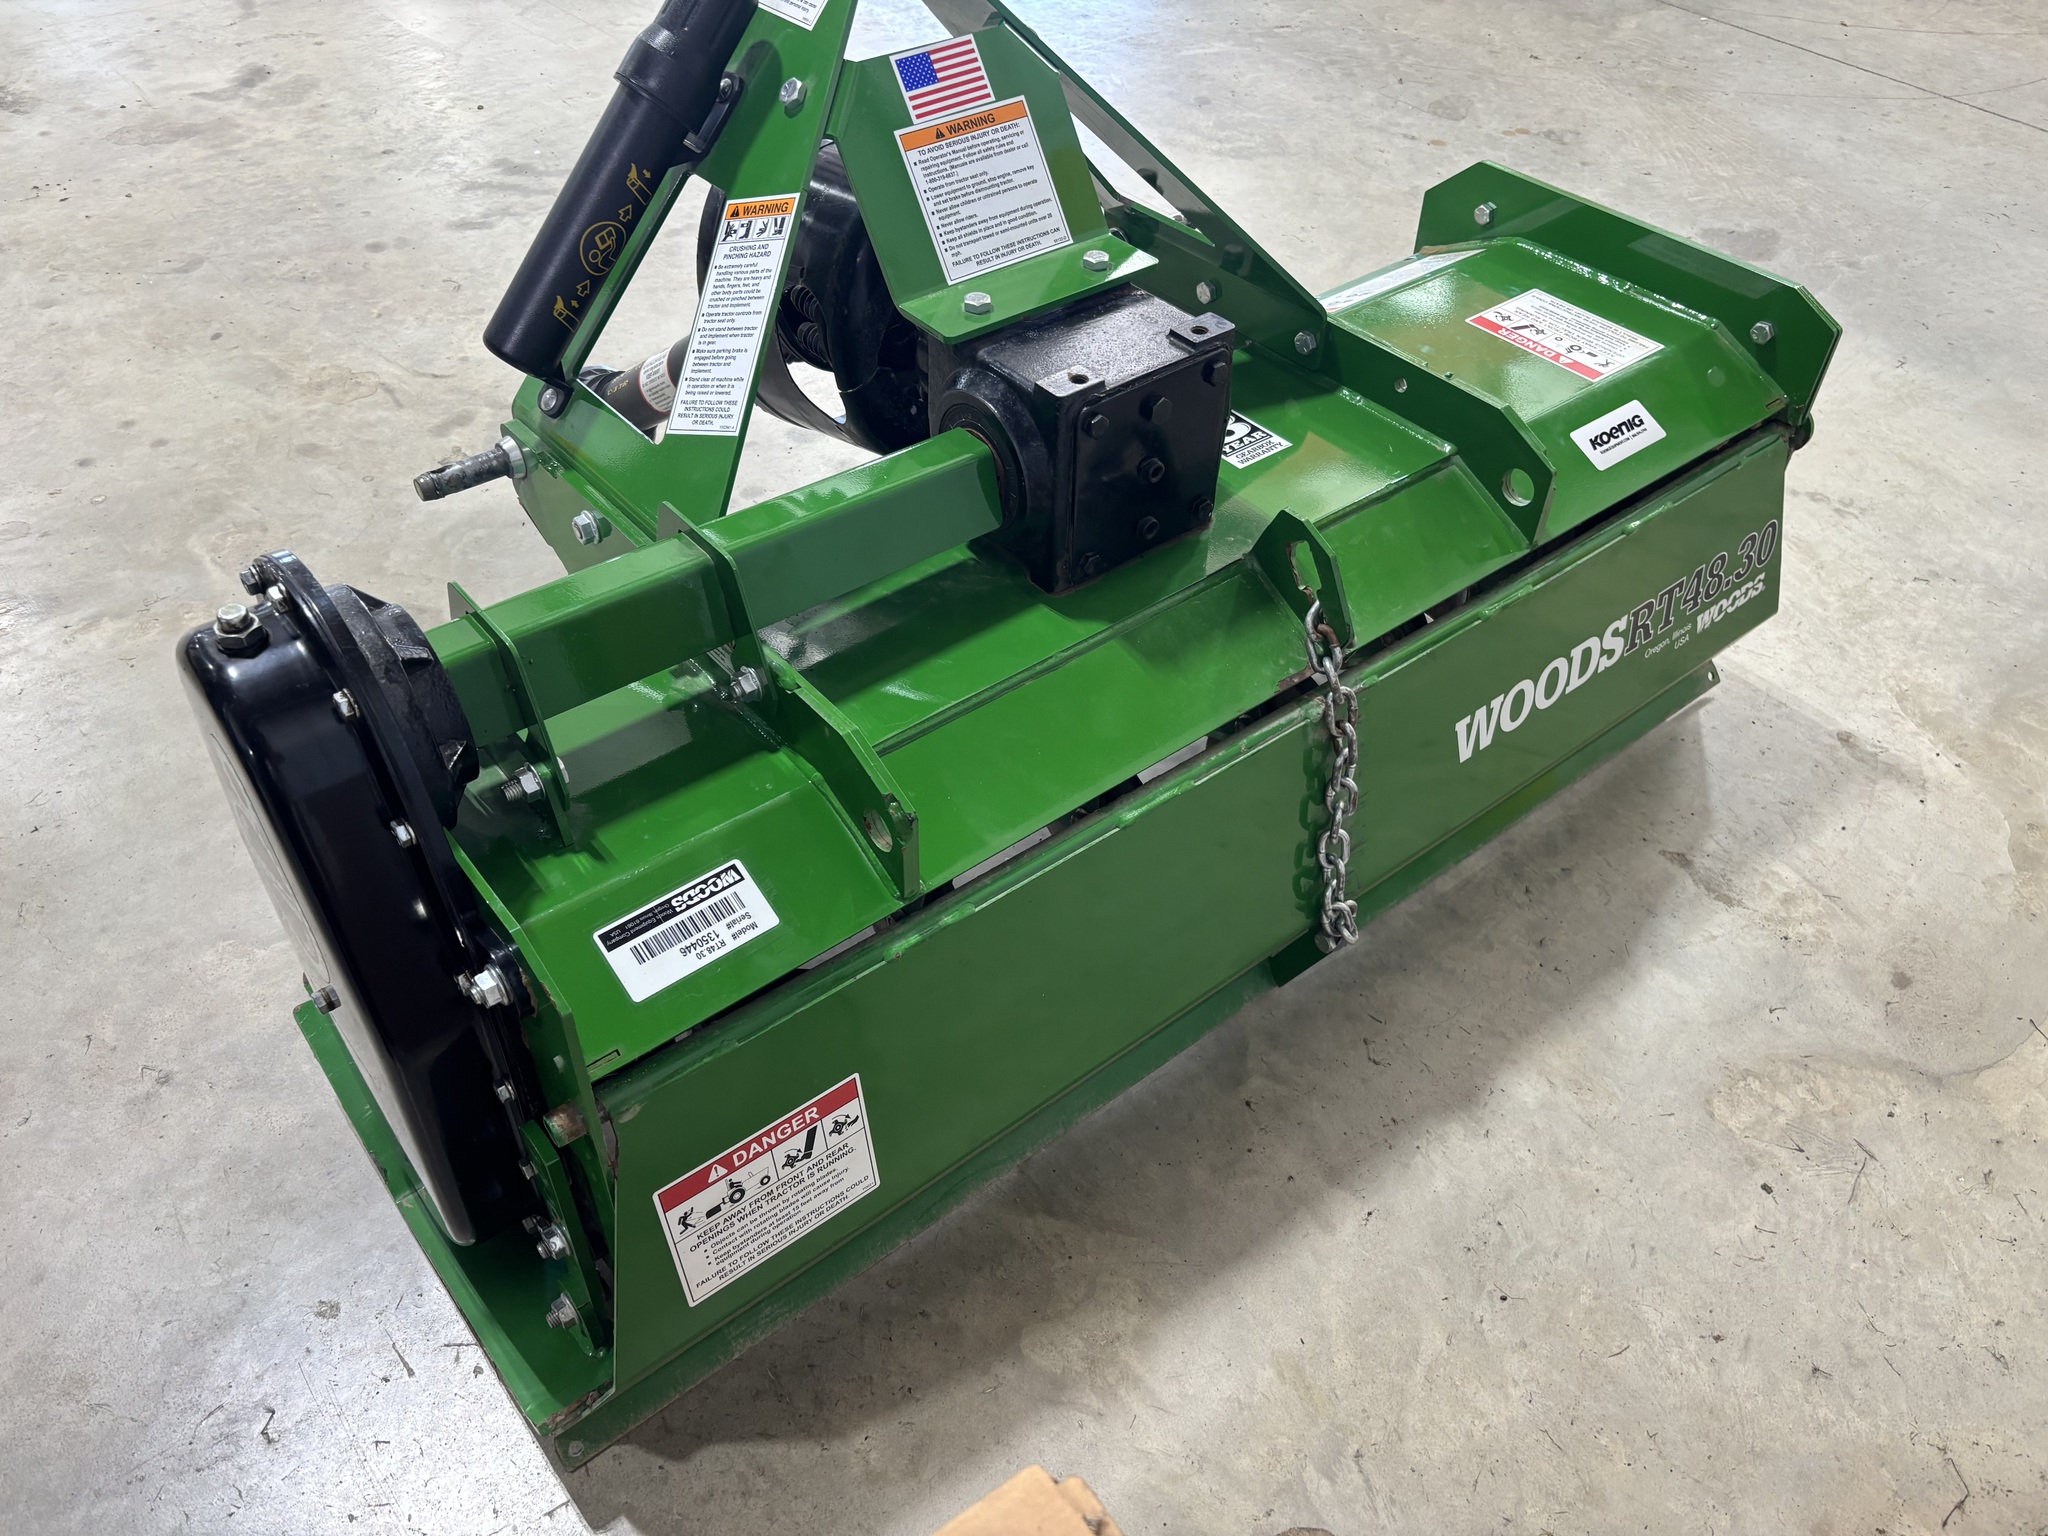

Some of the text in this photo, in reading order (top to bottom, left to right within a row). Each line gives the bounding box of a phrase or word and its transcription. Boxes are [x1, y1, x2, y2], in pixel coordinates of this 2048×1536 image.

[917, 121, 1020, 156] TO AVOID SERIOUS INJURY OR DEATH:
[945, 112, 996, 135] WARNING
[917, 156, 929, 165] Read
[929, 150, 951, 162] Operator's
[951, 145, 967, 155] Manual
[966, 142, 980, 150] before
[980, 136, 1000, 147] operating,
[1000, 130, 1020, 141] servicing
[919, 161, 940, 172] repairing
[939, 154, 962, 167] equipment.
[962, 150, 976, 159] Follow
[982, 145, 995, 154] safety
[994, 141, 1005, 149] rules
[927, 183, 945, 193] Operate
[954, 175, 969, 184] tractor
[978, 169, 989, 177] only.
[930, 191, 944, 200] Lower
[943, 185, 966, 197] equipment
[970, 178, 987, 189] ground,
[986, 175, 997, 184] stop
[996, 171, 1012, 181] engine,
[1011, 167, 1027, 175] remove
[1026, 163, 1035, 171] key
[932, 199, 941, 207] and
[948, 193, 961, 202] brake
[960, 189, 974, 198] before
[974, 181, 1000, 194] dismounting
[999, 177, 1014, 186] tractor.
[741, 201, 789, 216] WARNING
[940, 212, 978, 229] Never allow riders.
[722, 250, 771, 260] PINCHING HAZARD
[728, 244, 756, 252] CRUSHING
[951, 256, 972, 267] FAILURE
[979, 246, 1000, 258] FOLLOW
[1000, 241, 1016, 251] THESE
[1016, 229, 1049, 245] INSTRUCTIONS
[1049, 226, 1060, 234] CAN
[975, 255, 994, 266] RESULT
[1000, 248, 1017, 258] INJURY
[1024, 239, 1042, 249] DEATH.
[1494, 327, 1558, 357] DANGER
[1223, 431, 1267, 453] YEAR
[1236, 440, 1275, 459] GEARBOX
[1238, 442, 1282, 464] WARRANTY
[1697, 572, 1766, 634] WOODS
[1645, 623, 1692, 658] Oregon, Illinois
[1674, 634, 1689, 649] USA
[670, 868, 742, 912] WOODS
[604, 908, 673, 946] Woods Equipment Company
[609, 928, 621, 937] USA
[639, 911, 653, 921] Illinois
[678, 910, 752, 957] Serial# 1350446
[694, 920, 759, 960] Model# RT48.30
[733, 1106, 820, 1168] DANGER
[688, 1144, 856, 1253] OPENINGS WHEN TRACTOR IS RUNNING.
[696, 1141, 849, 1241] KEEP AWAY FROM FRONT AND REAR
[709, 1165, 838, 1250] Objects can be thrown by rotating blades.
[711, 1165, 850, 1255] Contact with rotating blades will cause injury.
[713, 1175, 844, 1262] Keep bystanders at least 15 feet away from
[695, 1264, 726, 1289] FAILURE
[728, 1257, 738, 1268] TO
[739, 1237, 769, 1261] FOLLOW
[771, 1222, 793, 1241] THESE
[794, 1190, 844, 1226] INSTRUCTIONS
[845, 1174, 869, 1193] COULD
[715, 1206, 803, 1267] equipment during operation.
[718, 1194, 848, 1281] RESULT IN SERIOUS INJURY OR DEATH.
